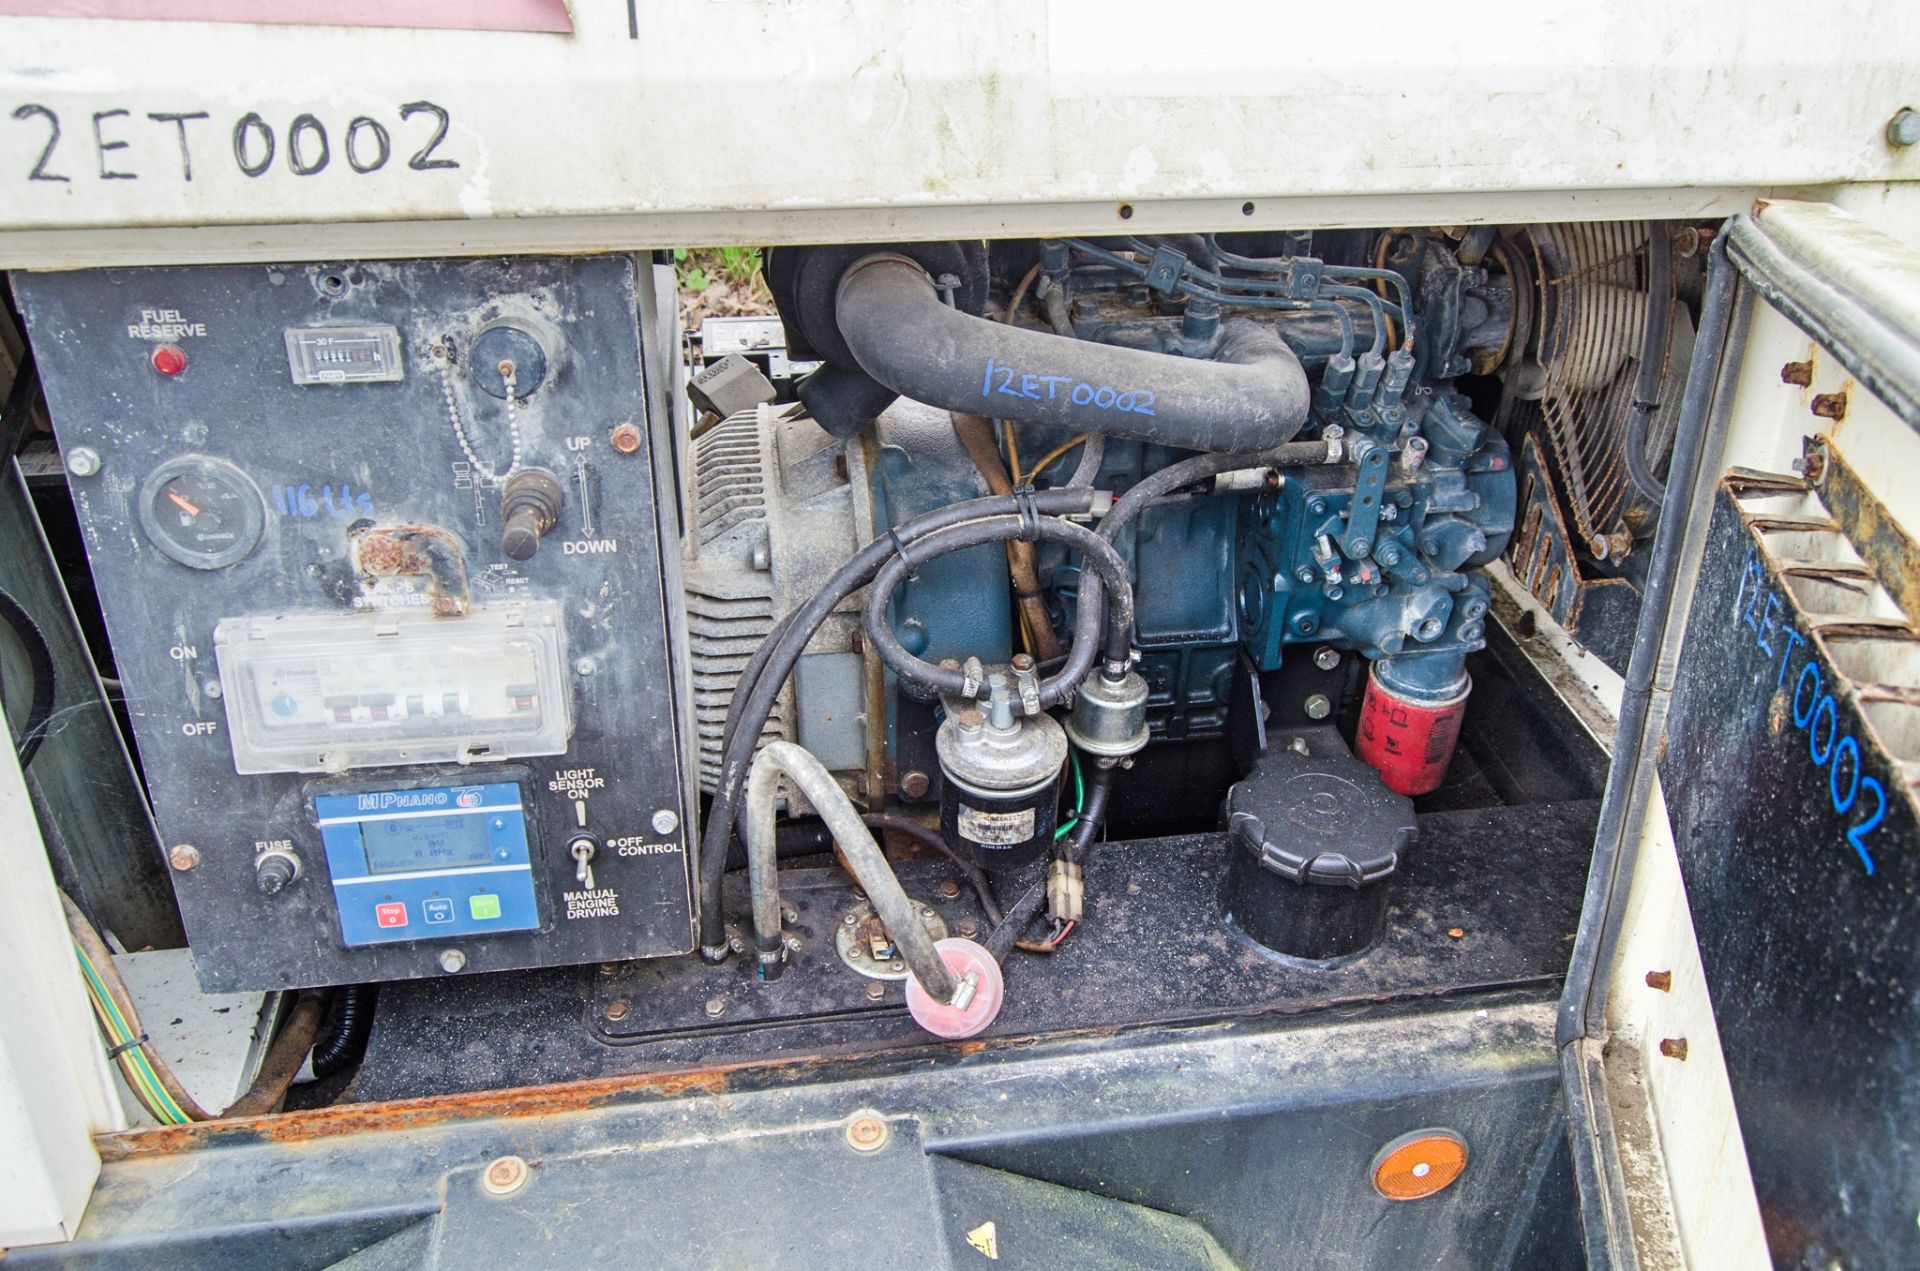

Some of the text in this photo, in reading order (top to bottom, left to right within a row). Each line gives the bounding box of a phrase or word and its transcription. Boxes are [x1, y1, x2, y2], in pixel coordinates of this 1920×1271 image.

[140, 309, 187, 323] FUEL
[127, 323, 207, 338] RESERVE
[981, 356, 1157, 417] 12ET0002
[566, 436, 591, 450] UP
[562, 539, 617, 554] DOWN
[489, 563, 509, 571] TEST
[169, 645, 198, 659] ON
[182, 721, 217, 735] OFF
[555, 768, 595, 780] LIGHT
[548, 777, 605, 790] SENSOR
[567, 788, 589, 799] ON
[254, 839, 293, 852] FUSE
[617, 836, 643, 847] OFF
[618, 842, 682, 856] CONTROL
[563, 888, 618, 900] MANUAL
[428, 902, 448, 911] Auto
[567, 897, 616, 910] ENGINE
[381, 907, 401, 916] Stop
[566, 906, 619, 919] DRIVING
